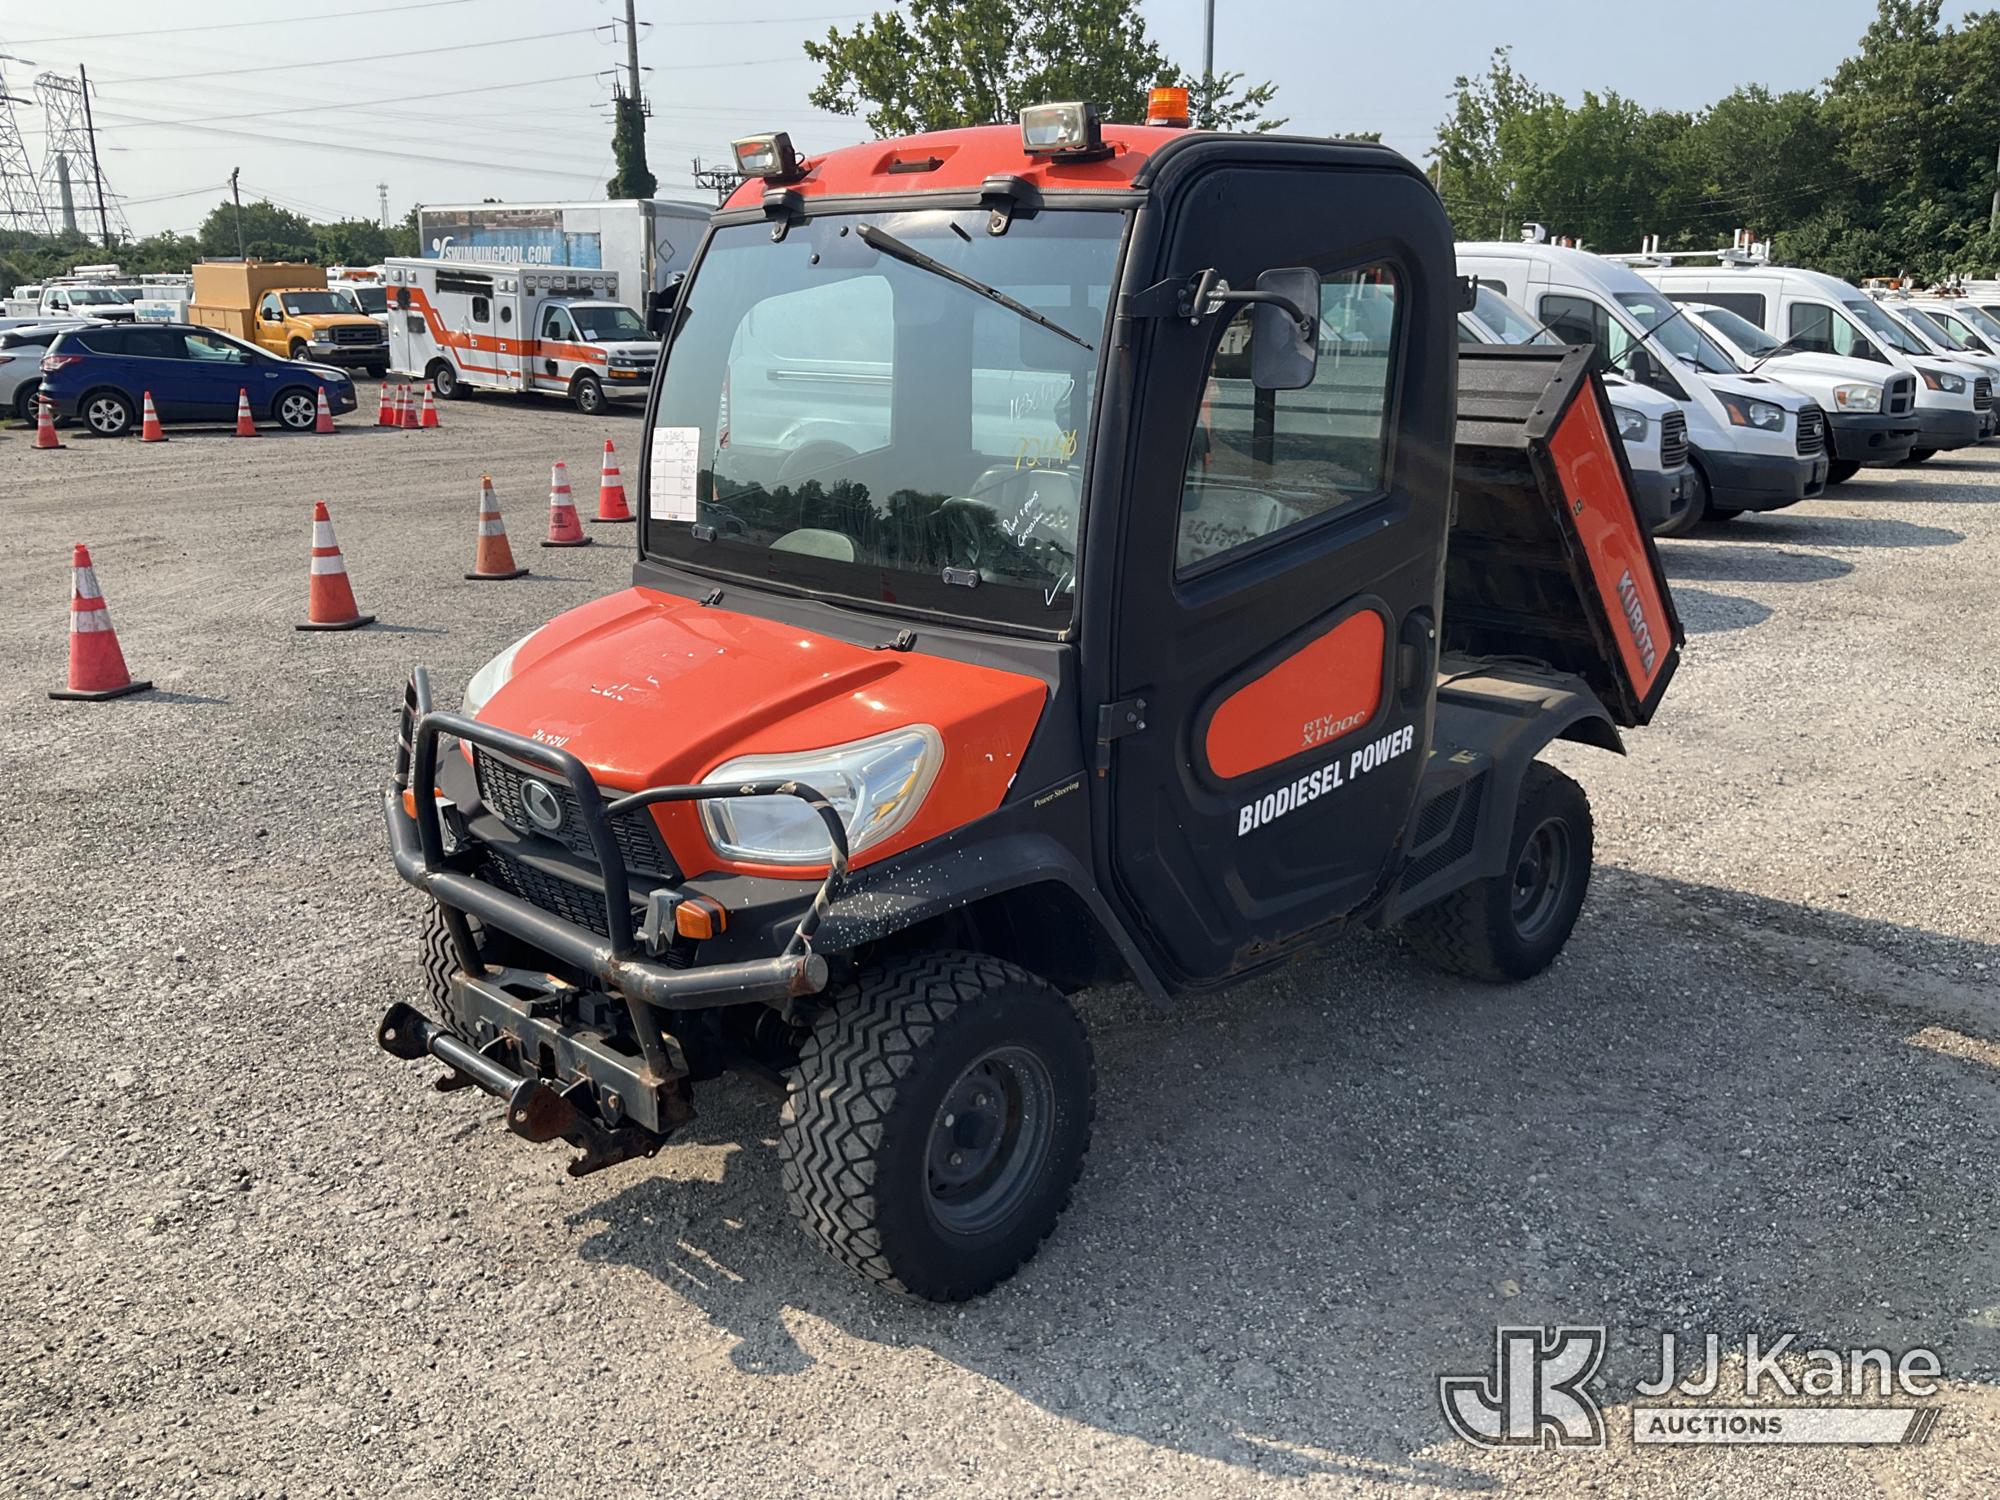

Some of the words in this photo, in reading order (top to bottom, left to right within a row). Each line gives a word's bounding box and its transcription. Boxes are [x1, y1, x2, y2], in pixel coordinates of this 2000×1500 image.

[446, 246, 551, 262] SWIMMINGPOOL.COM
[1617, 568, 1656, 678] KUBOTA
[1302, 711, 1366, 747] X1100C
[1303, 714, 1333, 733] RTV
[1033, 794, 1054, 808] Power
[1054, 781, 1080, 799] Steering
[1237, 760, 1344, 837] BIODIESEL
[1349, 724, 1414, 780] POWER
